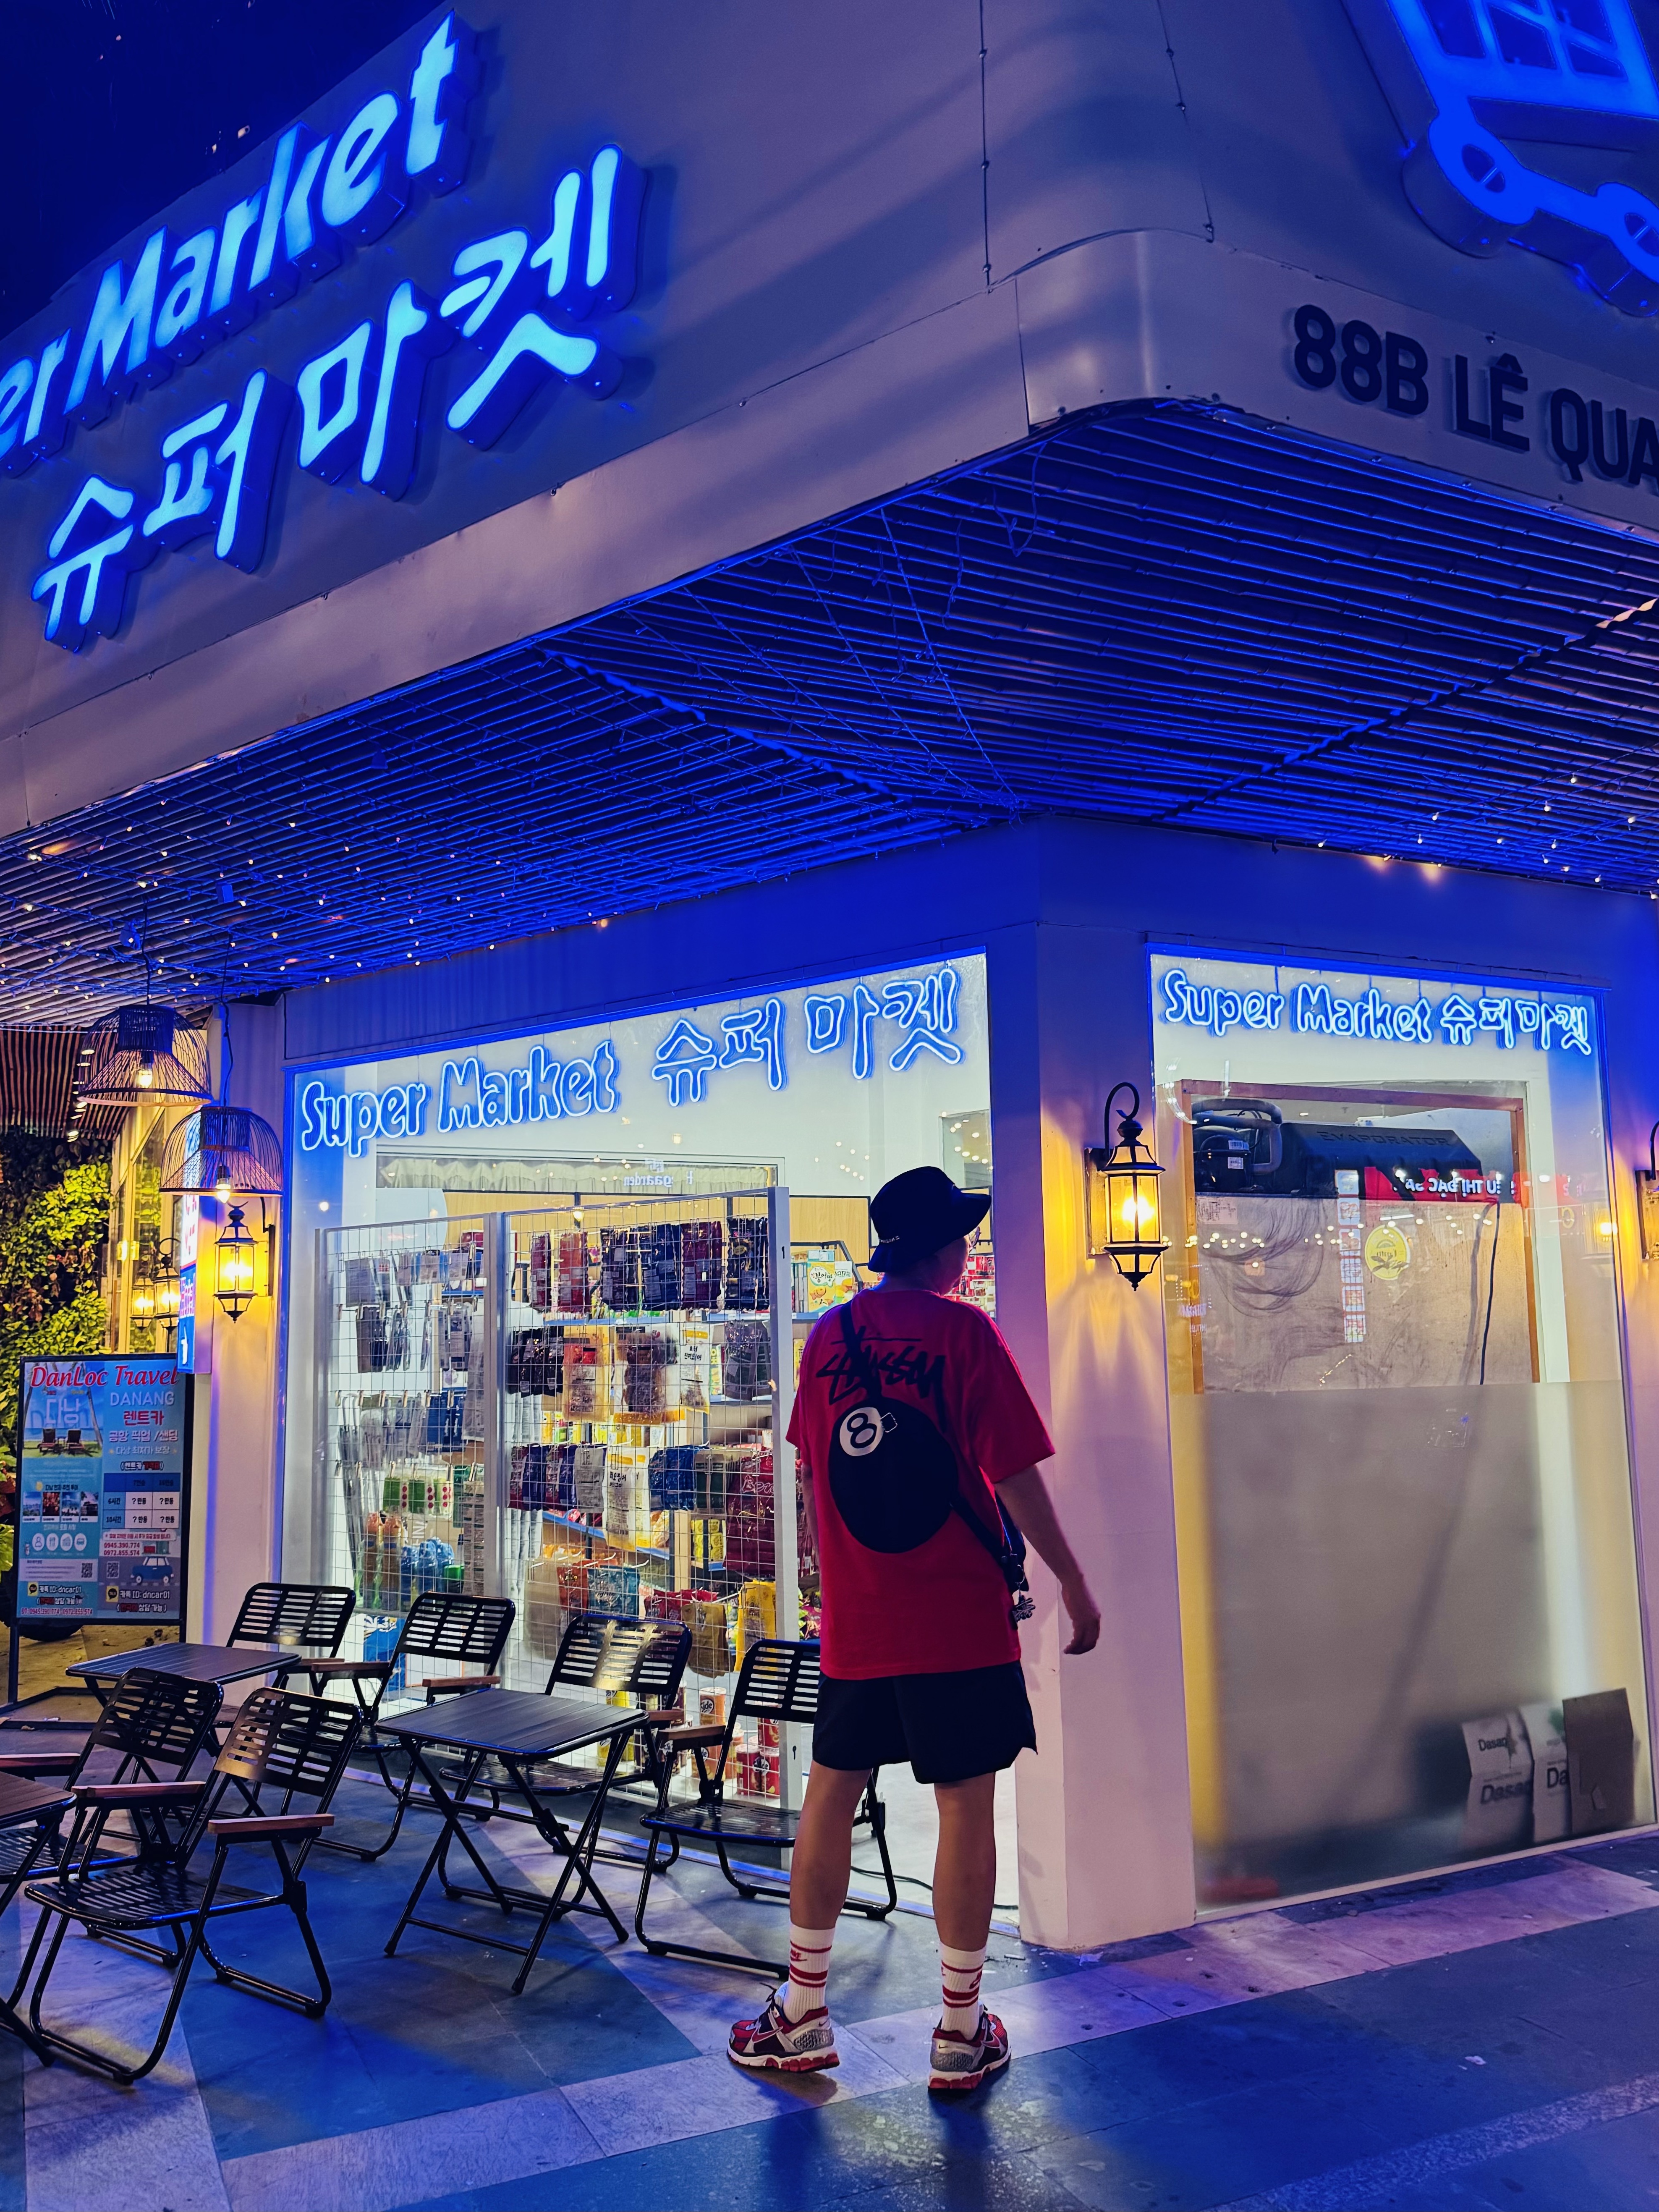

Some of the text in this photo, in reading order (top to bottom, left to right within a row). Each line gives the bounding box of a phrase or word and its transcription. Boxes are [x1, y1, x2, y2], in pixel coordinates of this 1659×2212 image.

[64, 10, 458, 416] Market
[1294, 305, 1429, 416] 88B
[1455, 353, 1530, 452] LÊ
[1163, 969, 1285, 1037] Super
[1295, 983, 1432, 1044] Market
[301, 1081, 431, 1158] Super
[438, 1041, 620, 1133] Market
[31, 1364, 178, 1387] DanLoc Travel
[46, 1398, 81, 1424] 다낭
[110, 1391, 175, 1406] DANANG
[123, 1410, 164, 1426] 렌트카
[847, 1413, 878, 1449] 8
[109, 1430, 128, 1442] 공항
